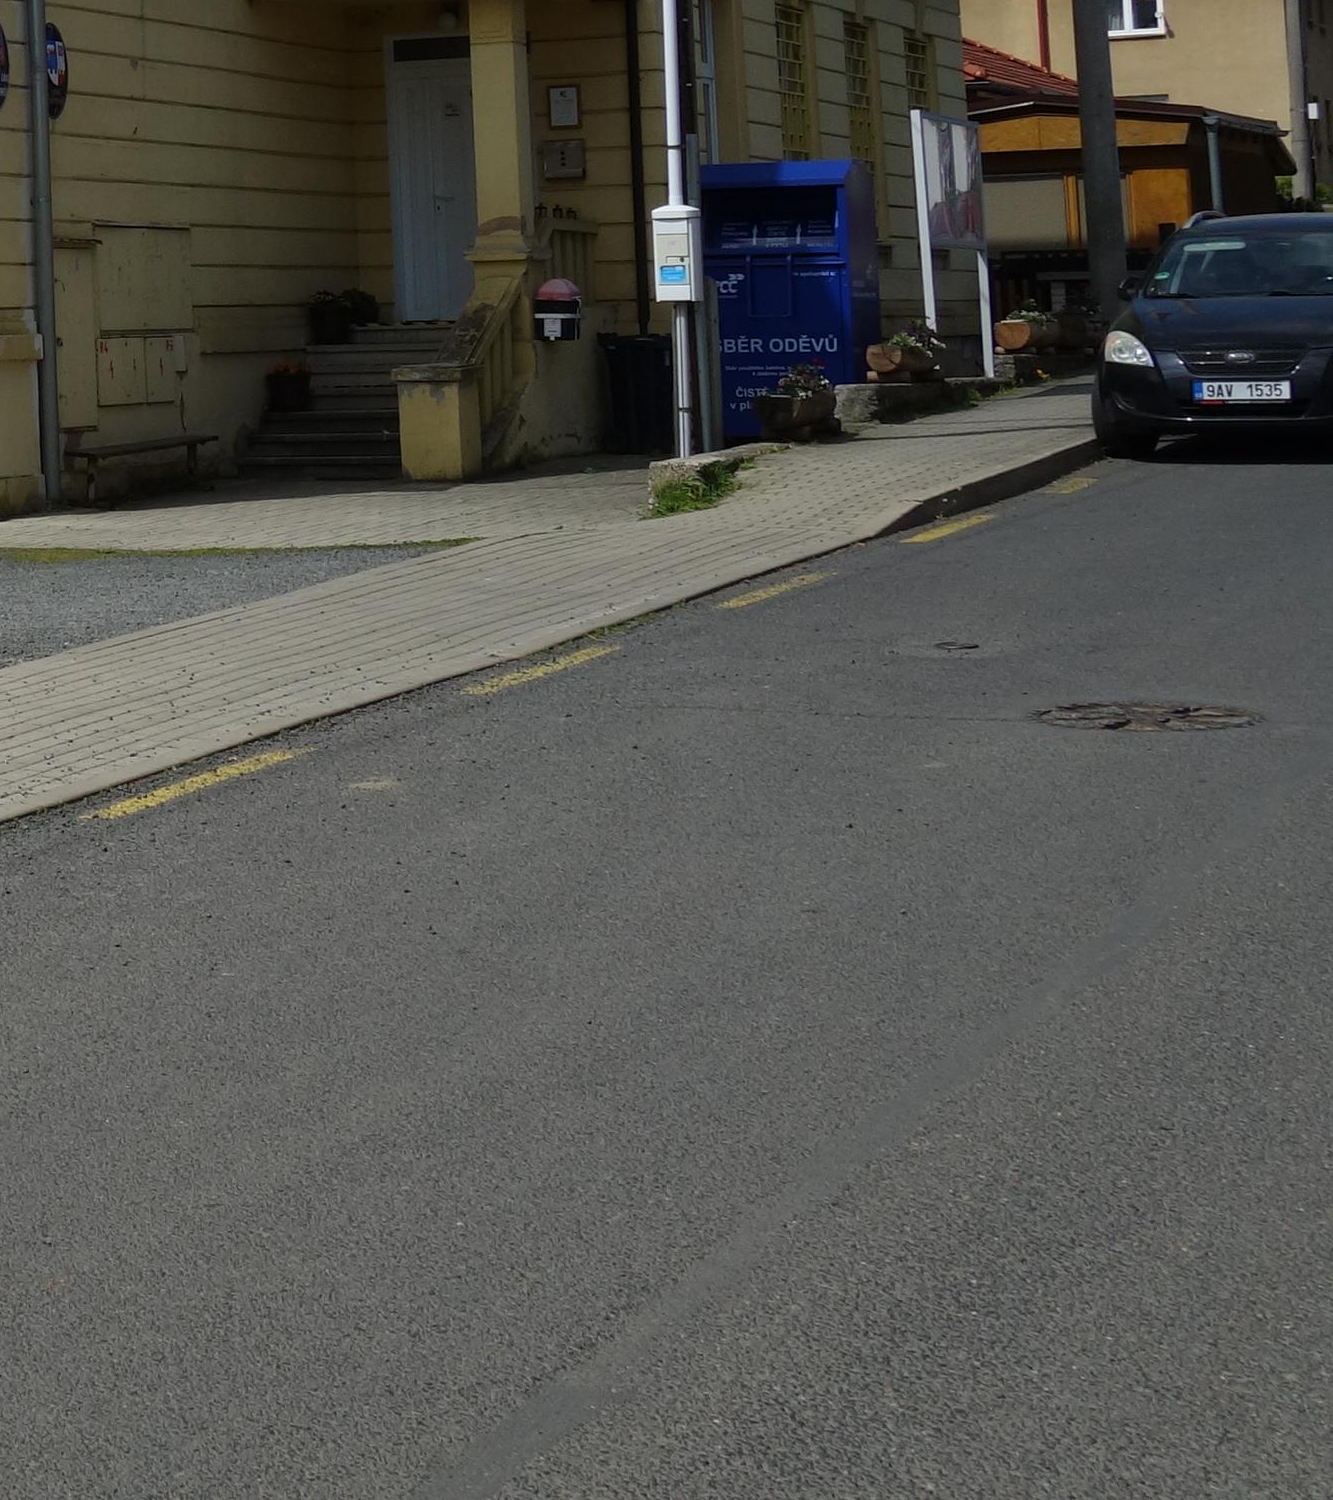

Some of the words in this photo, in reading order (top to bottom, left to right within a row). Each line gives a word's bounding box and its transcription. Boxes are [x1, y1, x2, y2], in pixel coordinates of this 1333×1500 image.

[769, 334, 838, 353] ODĚVŮ
[1206, 384, 1234, 397] 9AV
[1246, 384, 1283, 397] 1535
